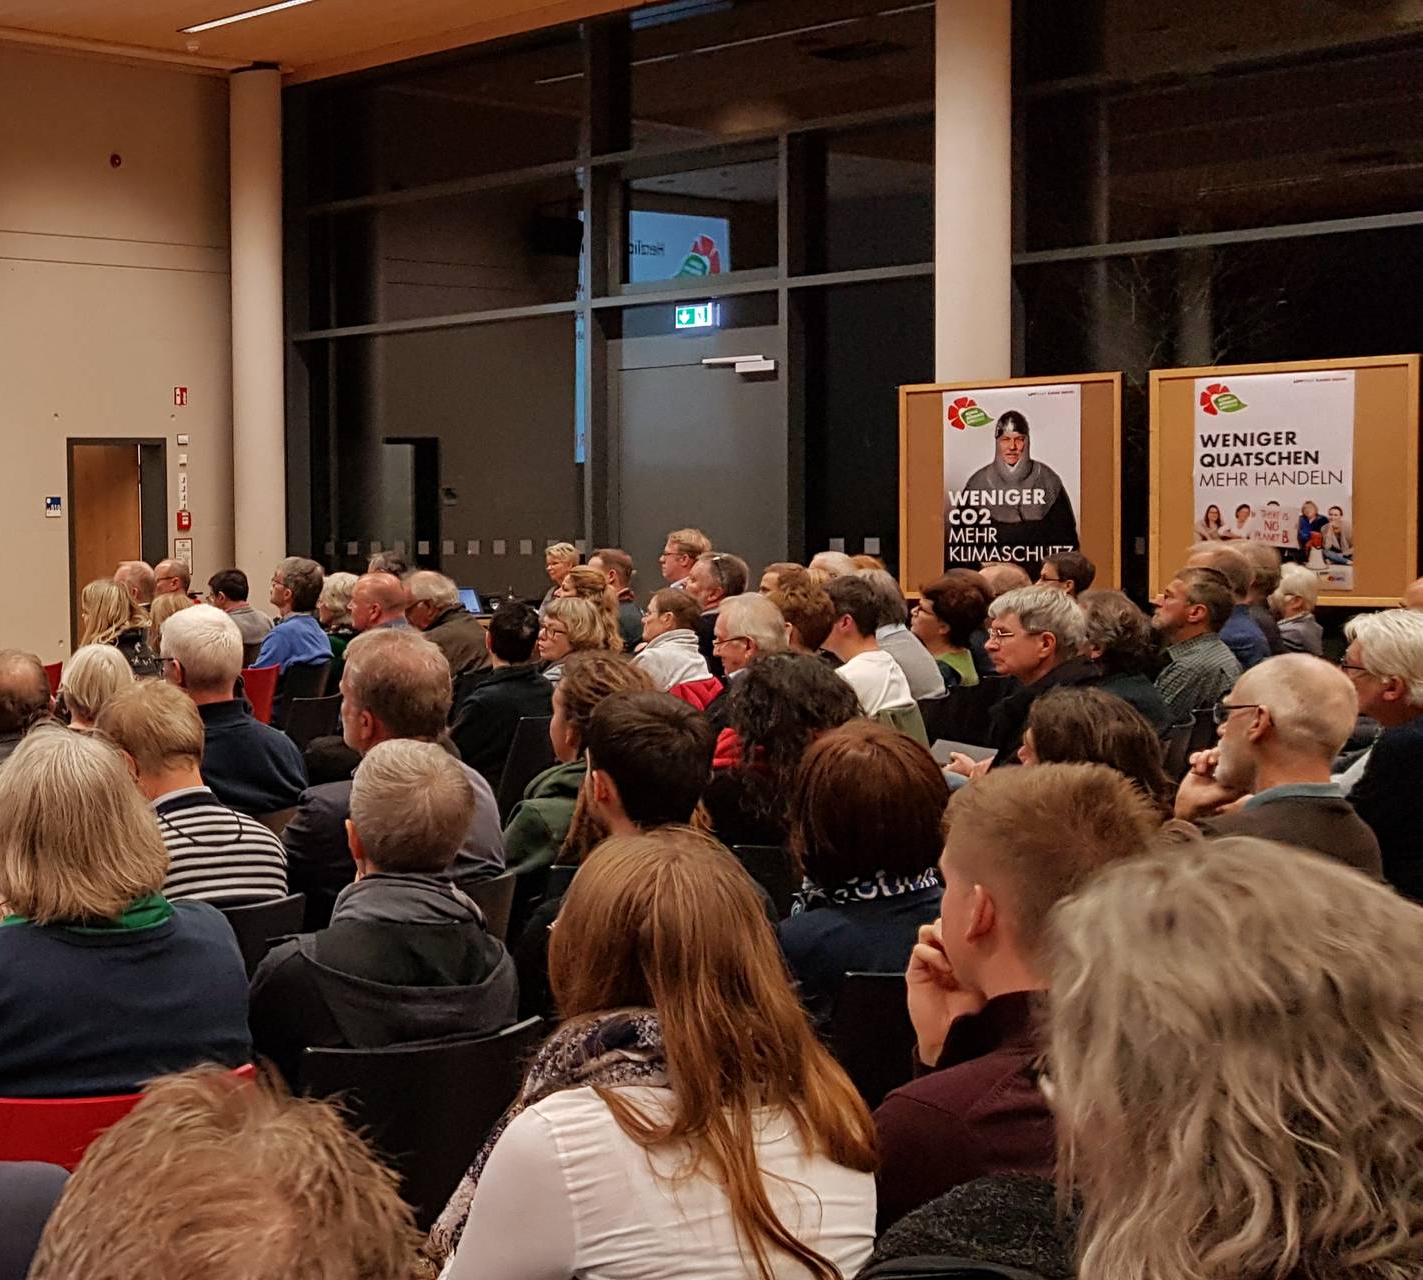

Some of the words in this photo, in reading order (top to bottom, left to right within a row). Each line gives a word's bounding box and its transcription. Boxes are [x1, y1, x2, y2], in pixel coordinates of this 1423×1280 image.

[1199, 431, 1297, 448] WENIGER
[1199, 450, 1320, 468] QUATSCHEN
[1199, 472, 1249, 487] MEHR
[1255, 469, 1344, 486] HANDELN
[948, 488, 1046, 507] WENIGER
[948, 508, 992, 526] CO2
[948, 527, 998, 544] MEHR
